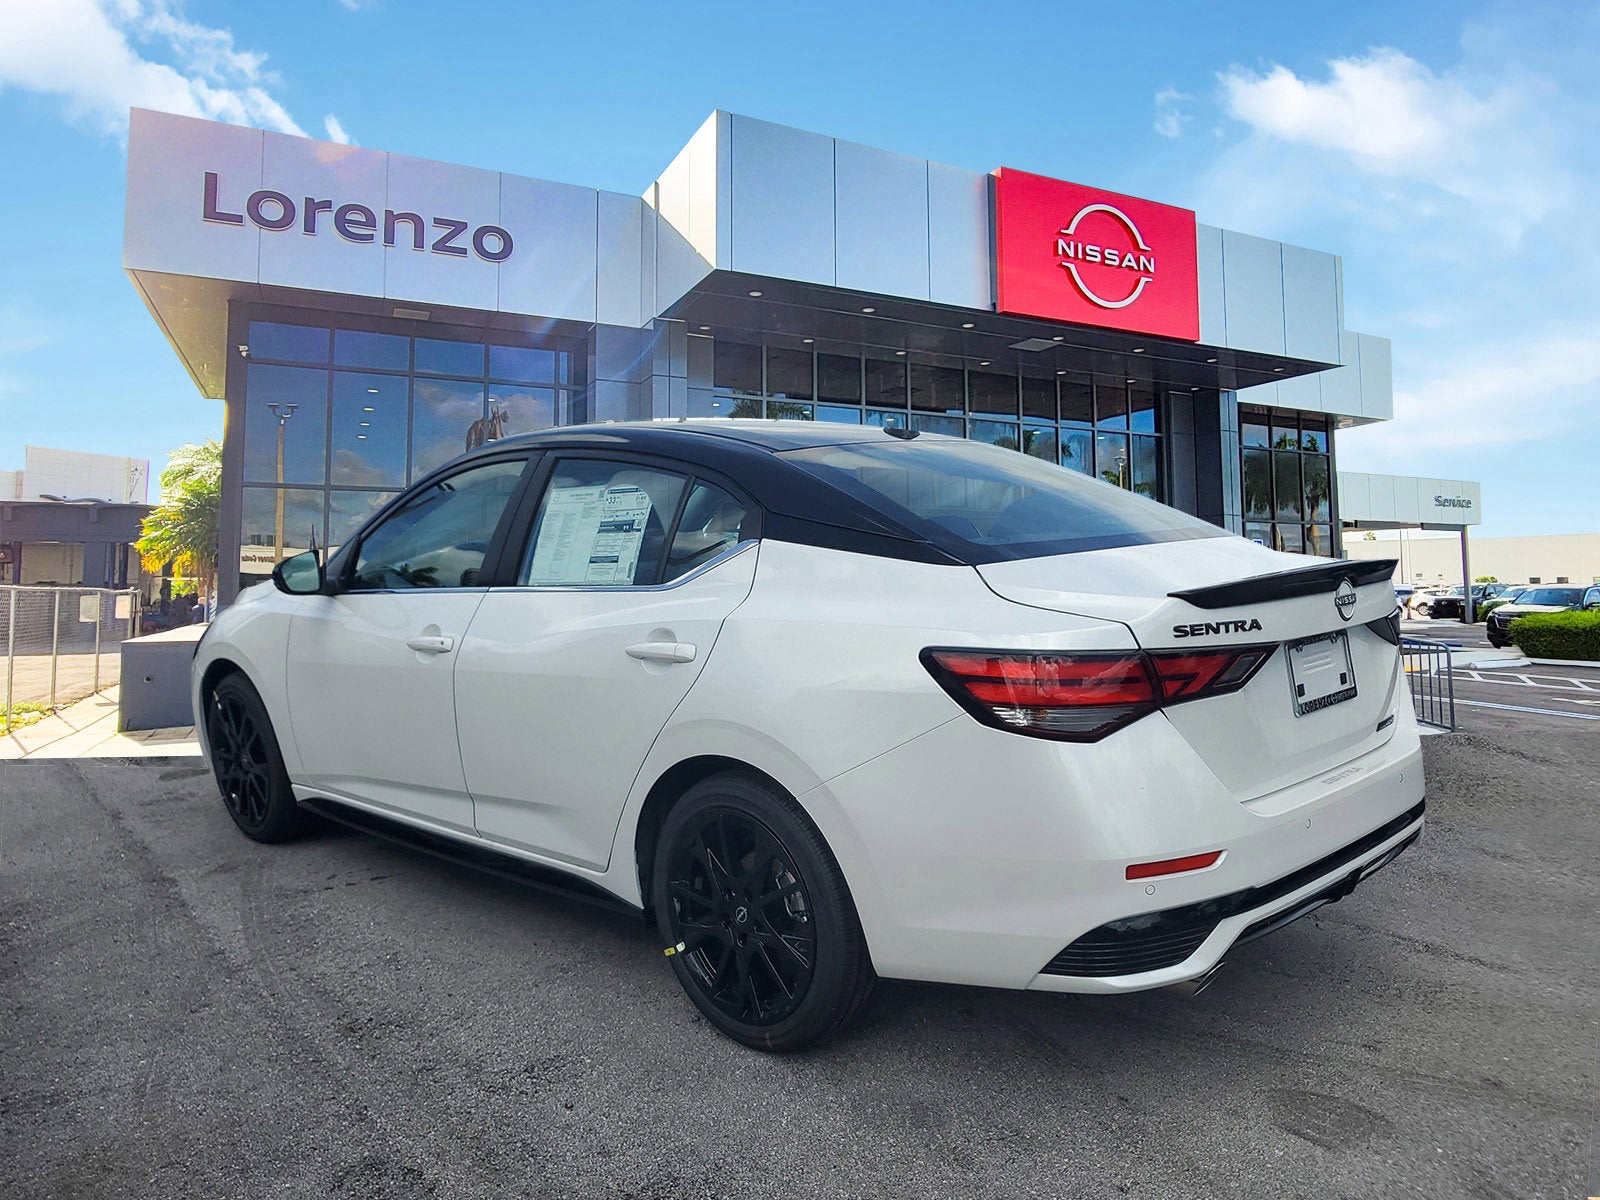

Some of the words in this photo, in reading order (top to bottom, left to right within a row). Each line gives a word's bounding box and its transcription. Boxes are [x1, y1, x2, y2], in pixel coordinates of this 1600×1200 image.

[202, 171, 515, 262] Lorenzo
[1057, 238, 1155, 273] NISSAN
[1434, 495, 1472, 508] Service
[1172, 618, 1263, 638] SENTRA
